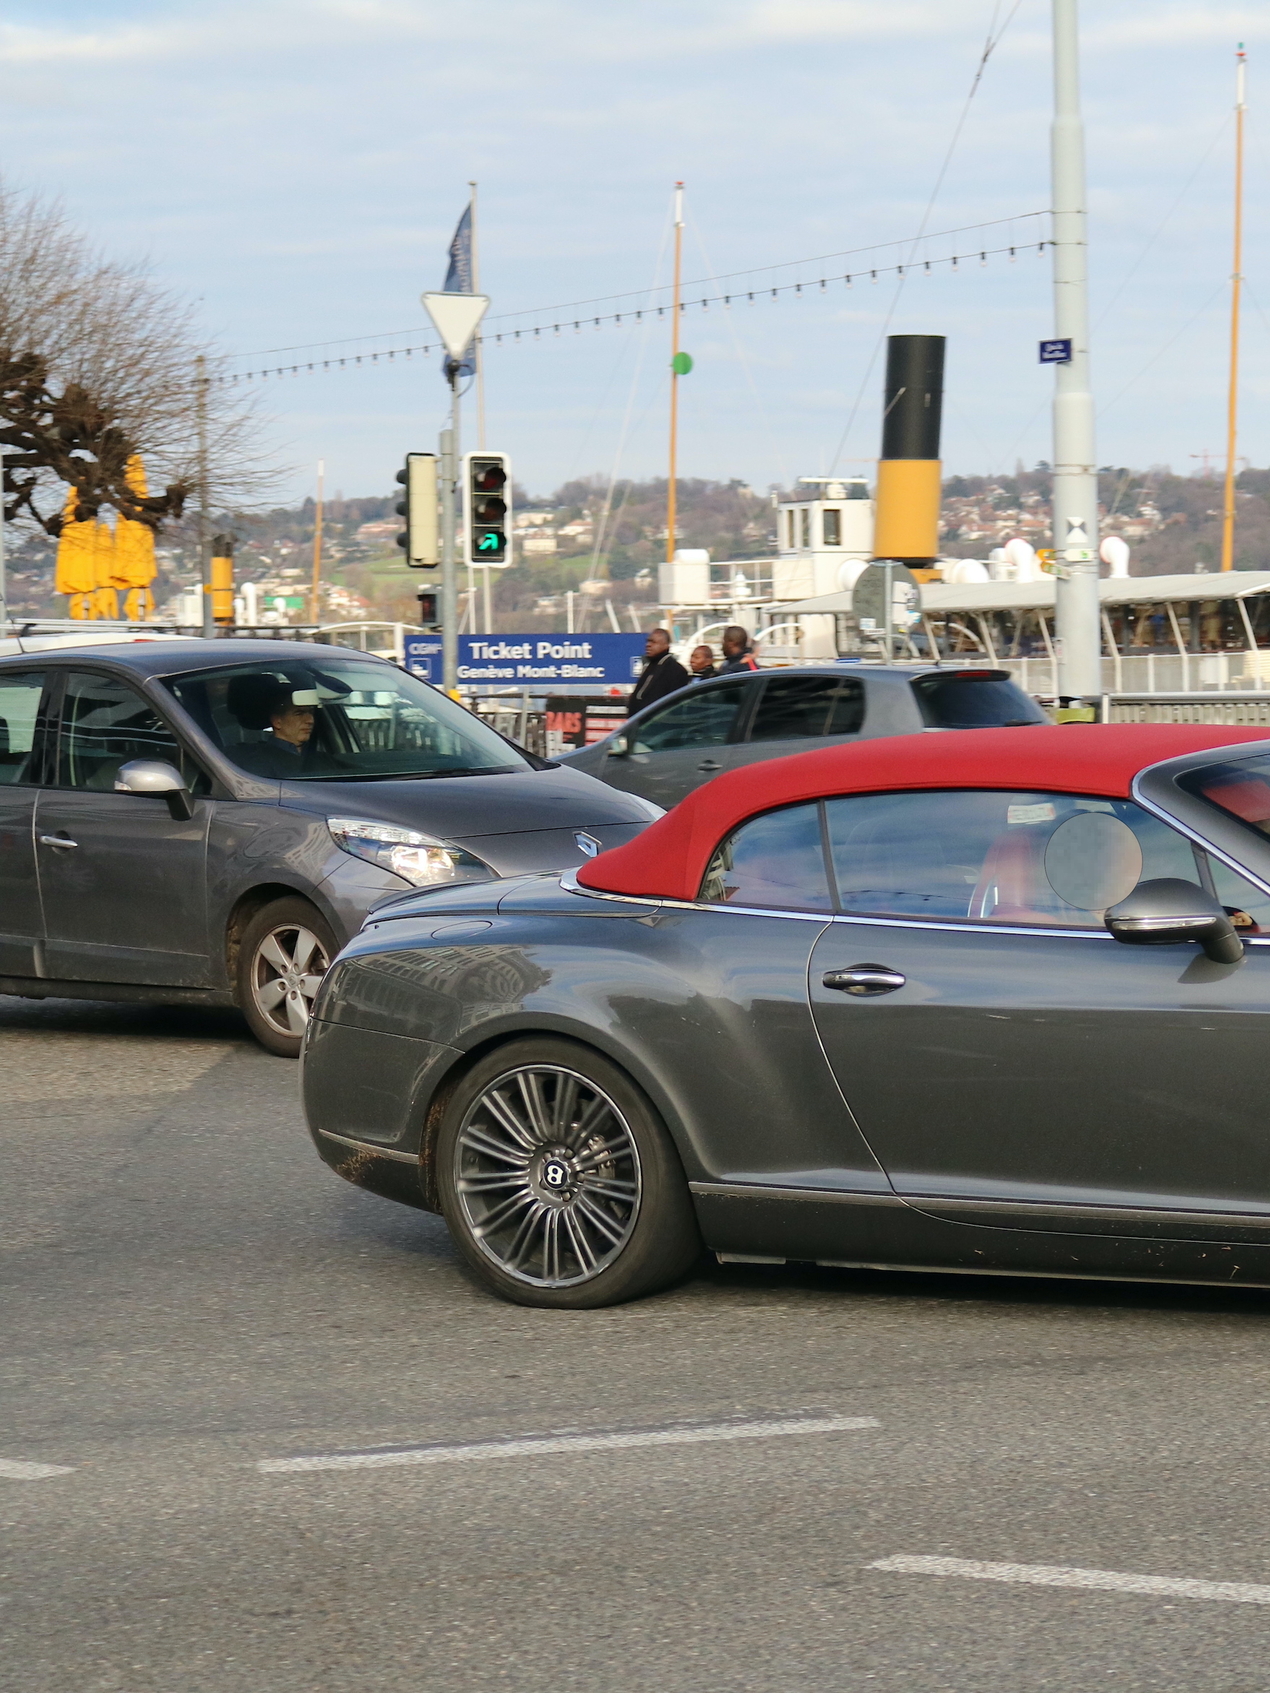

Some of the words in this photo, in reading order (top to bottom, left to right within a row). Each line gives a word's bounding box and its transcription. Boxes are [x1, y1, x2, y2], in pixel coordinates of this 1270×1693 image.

[468, 642, 533, 659] Ticket
[536, 641, 593, 659] Point
[456, 665, 515, 679] Genève
[516, 664, 606, 678] Mont-Blanc
